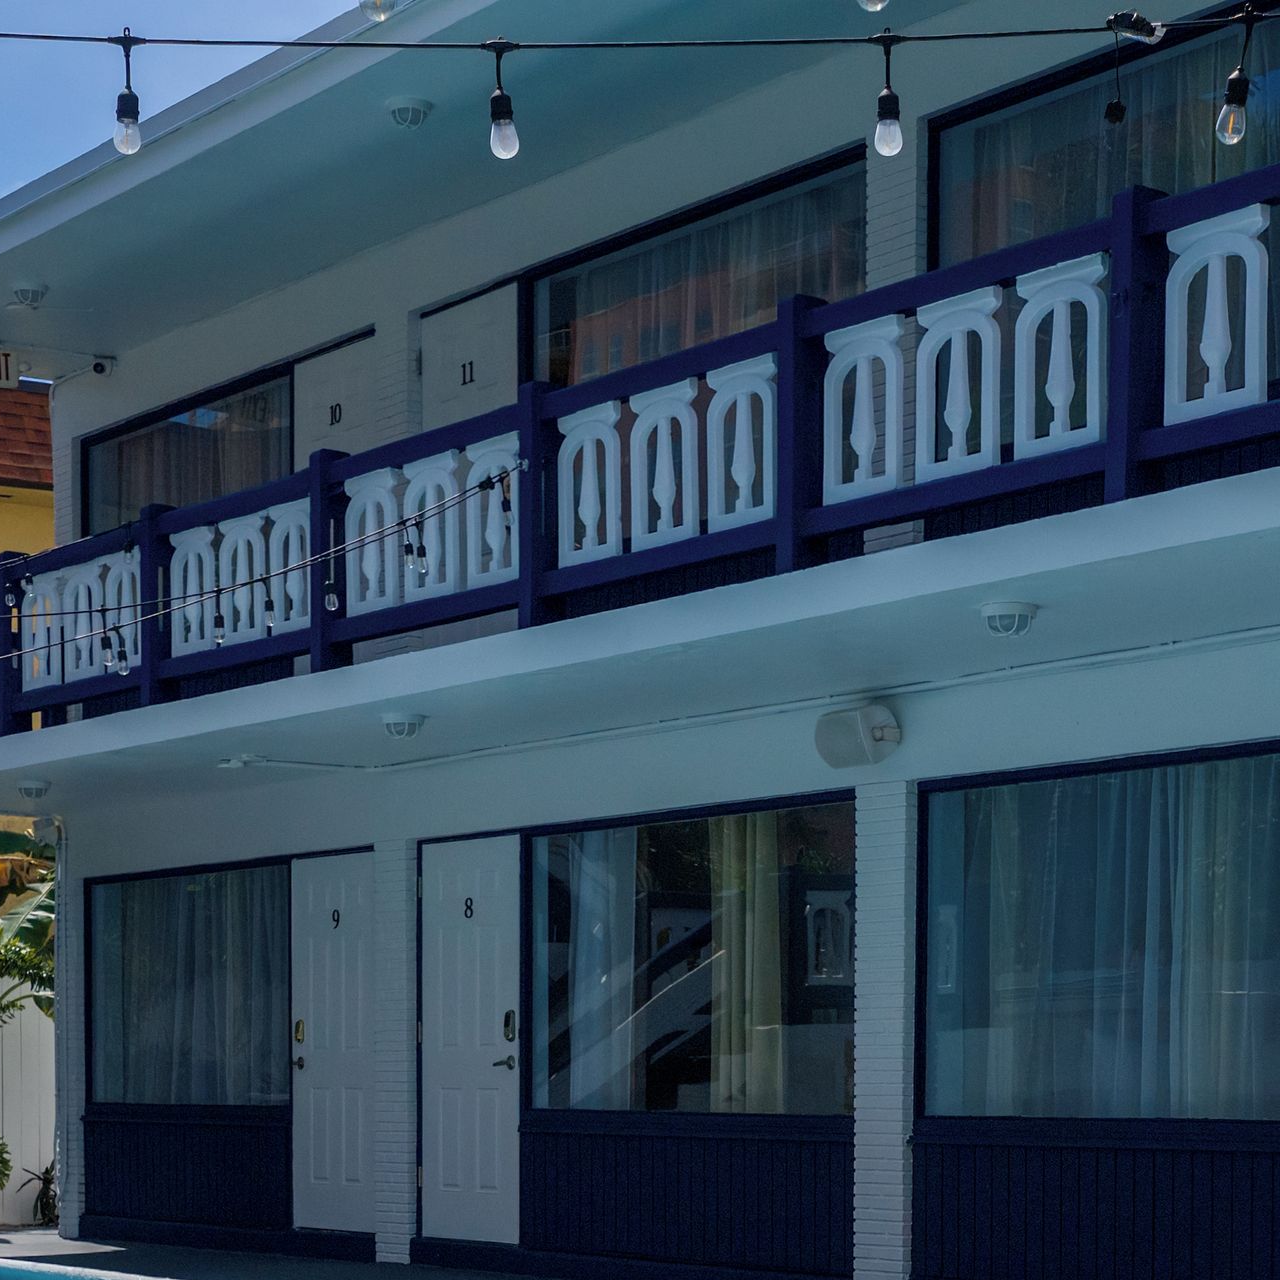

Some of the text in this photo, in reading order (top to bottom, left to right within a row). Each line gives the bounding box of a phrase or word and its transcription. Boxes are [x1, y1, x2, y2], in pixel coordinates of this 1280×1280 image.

[460, 360, 475, 386] 11
[329, 403, 342, 426] 10
[464, 897, 473, 918] 8
[332, 909, 340, 929] 9
